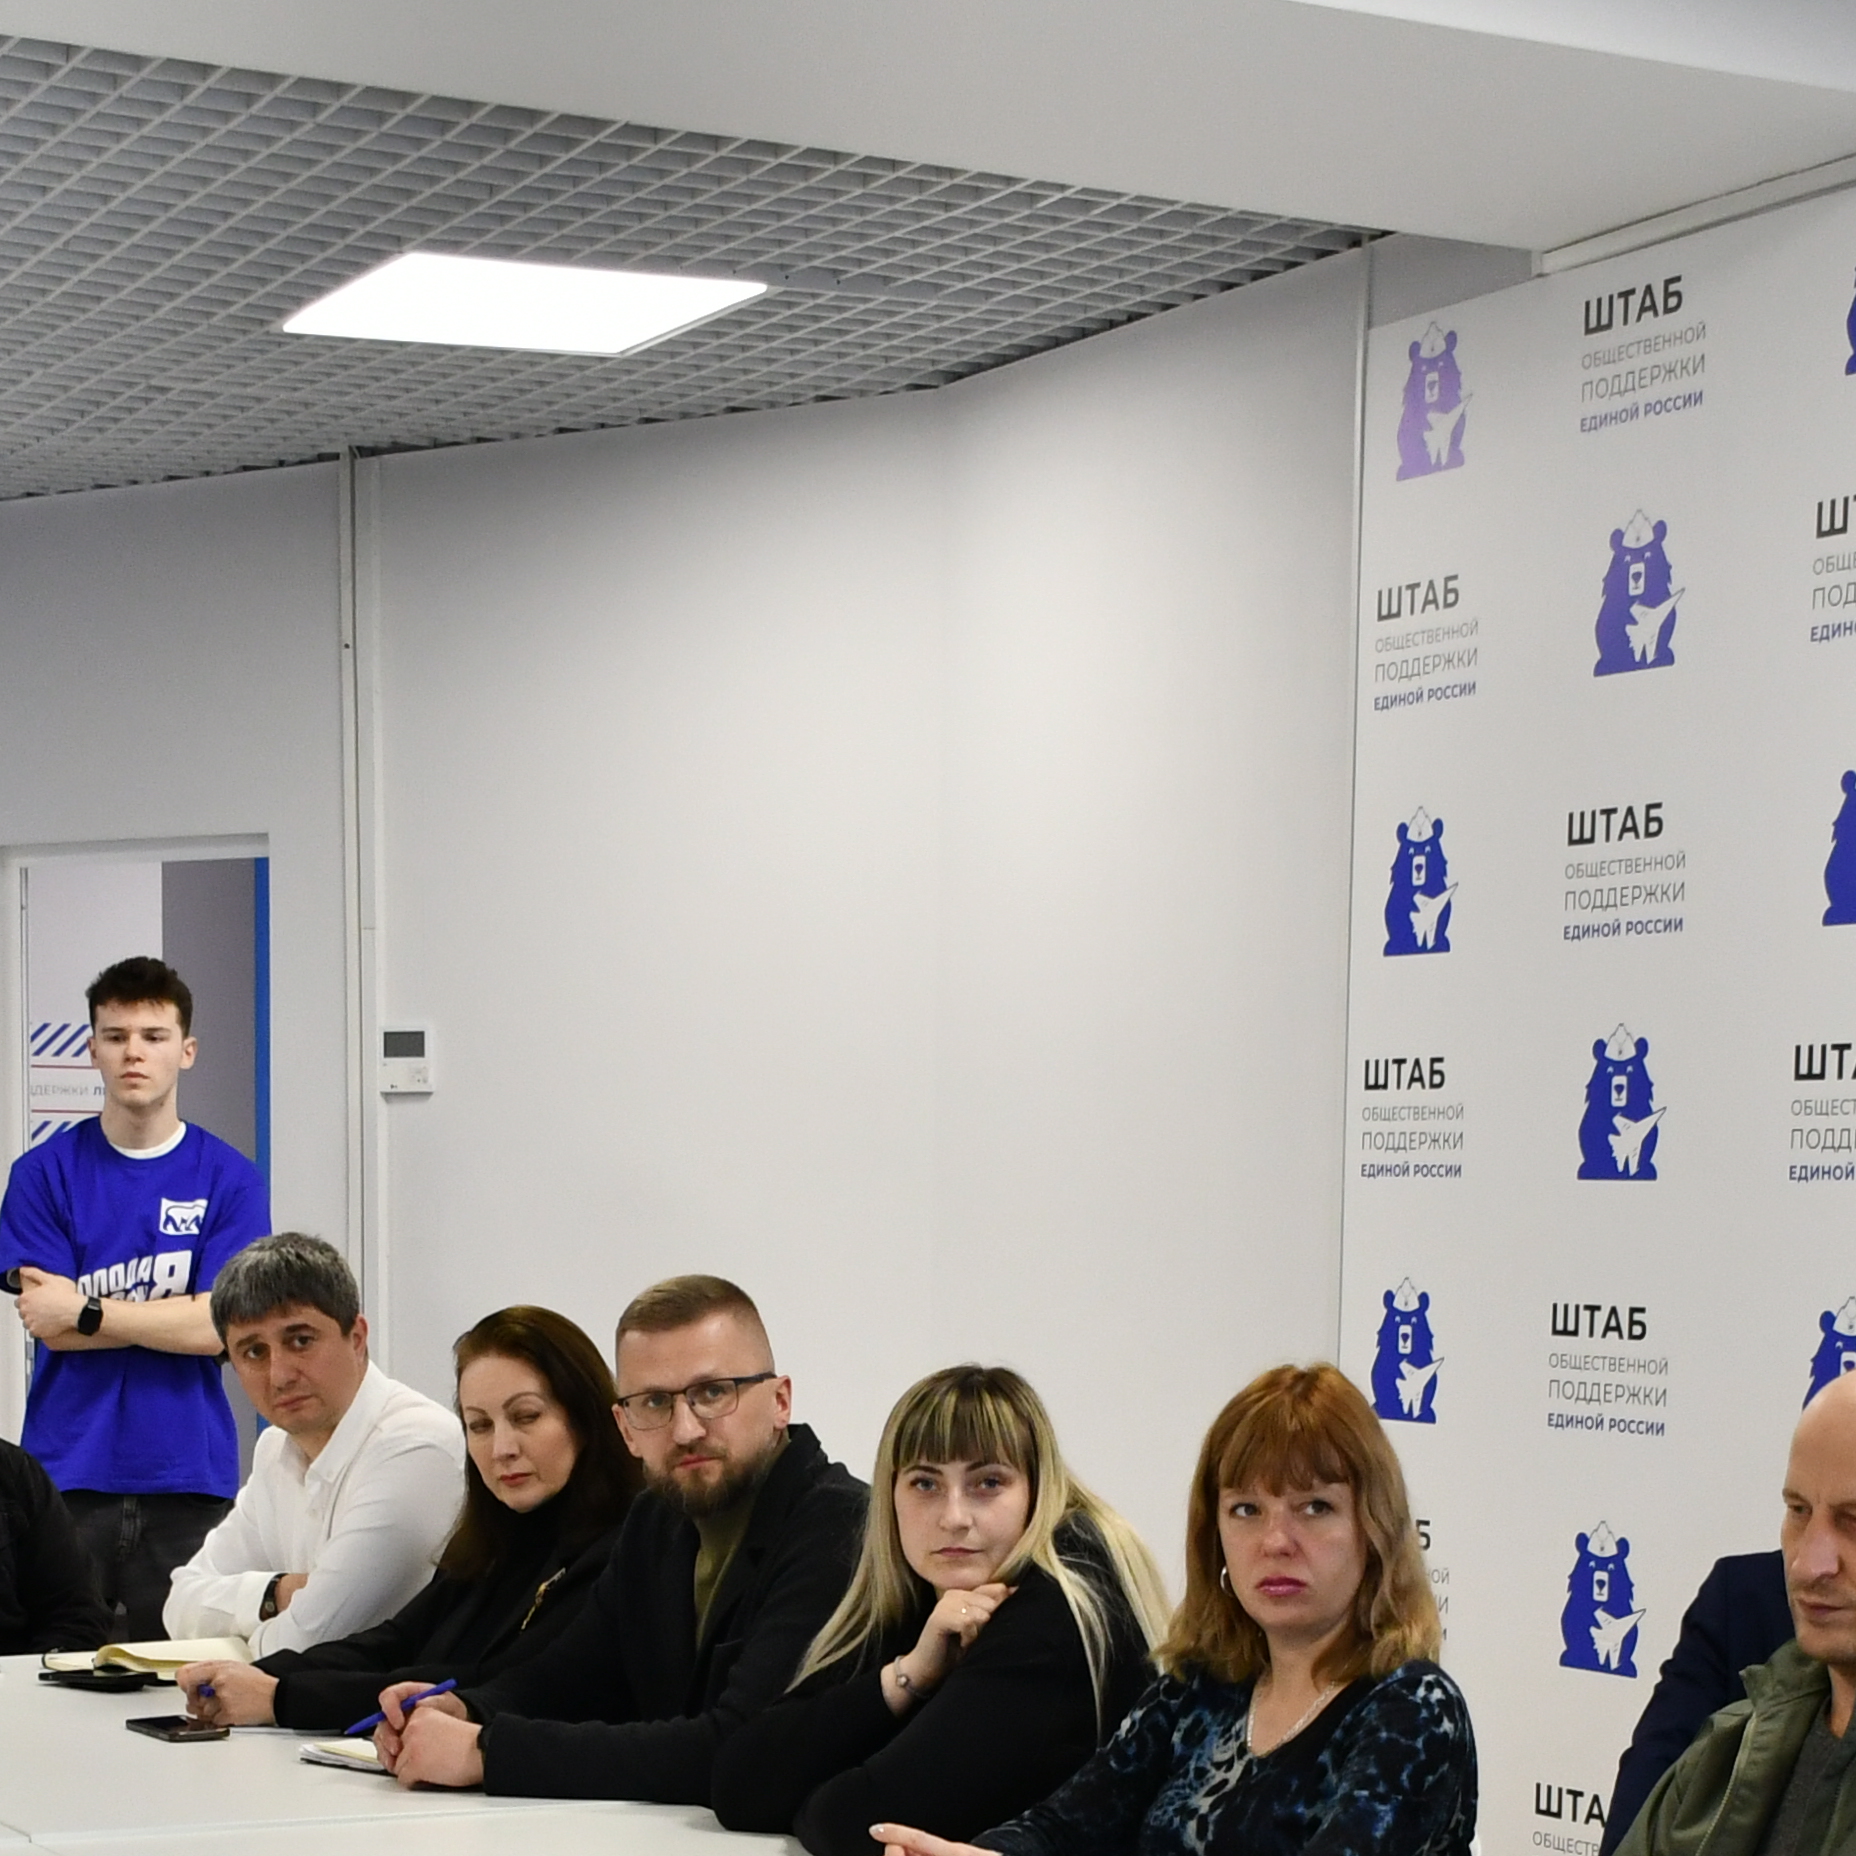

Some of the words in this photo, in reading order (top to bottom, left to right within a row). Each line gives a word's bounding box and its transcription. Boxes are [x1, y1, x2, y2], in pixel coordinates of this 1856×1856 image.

[1584, 274, 1683, 336] ШТАБ
[1581, 320, 1707, 371] ОБЩЕСТВЕННОЙ
[1581, 352, 1706, 402] ПОДДЕРЖКИ
[1579, 401, 1640, 433] ЕДИНОЙ
[1643, 389, 1704, 417] РОССИИ
[1376, 574, 1460, 622] ШТАБ
[1374, 619, 1480, 654] ОБЩЕСТВЕННОЙ
[1374, 646, 1479, 683] ПОДДЕРЖКИ
[1373, 686, 1425, 712] ЕДИНОЙ
[1427, 680, 1477, 702] РОССИИ
[1567, 802, 1664, 847] ШТАБ
[1564, 850, 1687, 880] ОБЩЕСТВЕННОЙ
[1564, 881, 1686, 913] ПОДДЕРЖКИ
[1563, 918, 1622, 942] ЕДИНОЙ
[1625, 917, 1684, 936] РОССИИ
[1364, 1056, 1446, 1091] ШТАБ
[1361, 1102, 1465, 1123] ОБЩЕСТВЕННОЙ
[1361, 1130, 1464, 1154] ПОДДЕРЖКИ
[1360, 1160, 1411, 1179] ЕДИНОЙ
[1413, 1163, 1462, 1178] РОССИИ
[1788, 1161, 1856, 1183] ЕДИНОЙ
[1551, 1302, 1647, 1341] ШТАБ
[1548, 1352, 1669, 1376] ОБЩЕСТВЕННОЙ
[1548, 1378, 1668, 1407] ПОДДЕРЖКИ
[1547, 1412, 1605, 1431] ЕДИНОЙ
[1608, 1417, 1666, 1437] РОССИИ
[1534, 1782, 1605, 1829] ШТА
